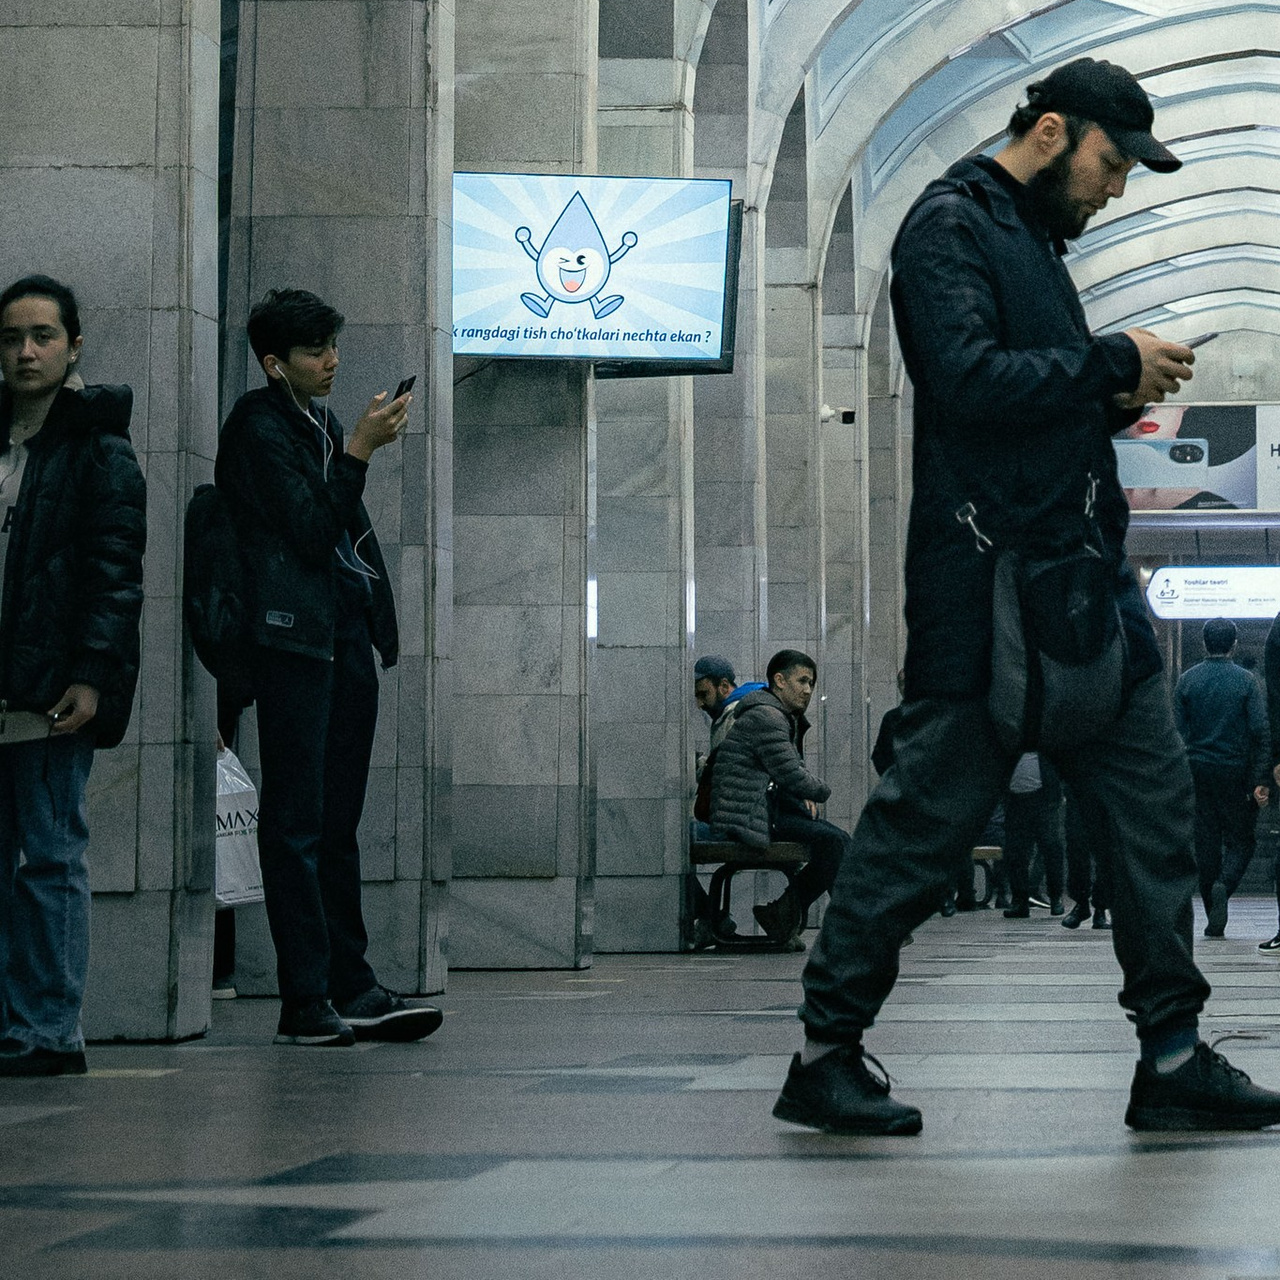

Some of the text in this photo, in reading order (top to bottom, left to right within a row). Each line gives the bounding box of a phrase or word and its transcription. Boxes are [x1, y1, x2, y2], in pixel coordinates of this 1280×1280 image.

[461, 326, 520, 341] rangdagi
[523, 327, 547, 340] tish
[622, 329, 668, 342] nechta
[670, 330, 702, 343] ekan
[705, 331, 712, 343] ?
